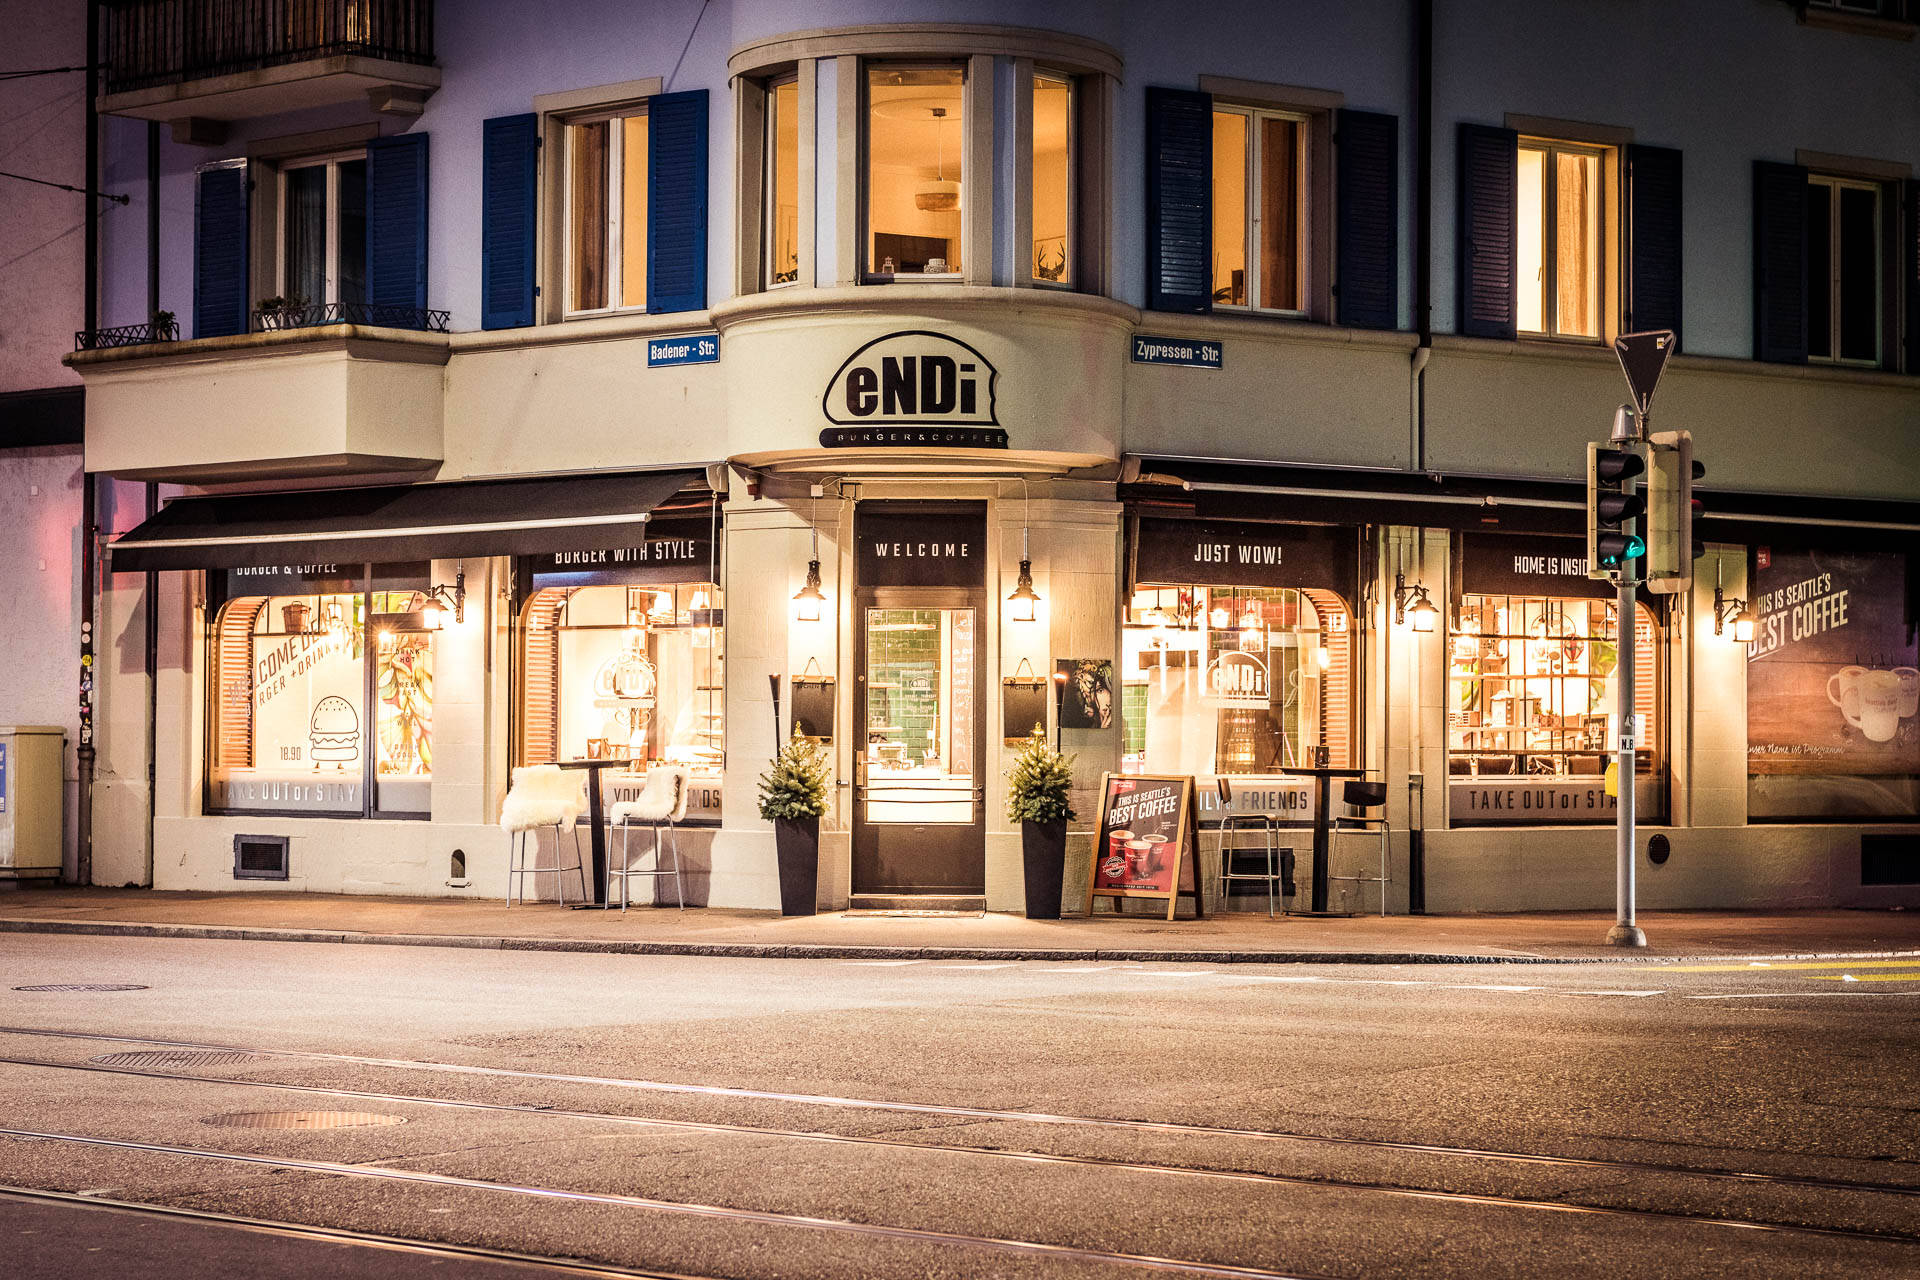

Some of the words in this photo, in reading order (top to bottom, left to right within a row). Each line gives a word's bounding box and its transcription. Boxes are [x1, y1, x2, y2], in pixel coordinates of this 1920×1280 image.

[651, 344, 689, 360] Badener
[698, 340, 715, 356] Str.
[1137, 341, 1192, 360] Zypressen
[1202, 345, 1219, 362] Str.
[846, 355, 976, 417] eNDi
[655, 540, 695, 560] STYLE
[875, 543, 968, 557] WELCOME
[1194, 543, 1230, 563] JUST
[1238, 545, 1282, 565] WOW!
[1514, 555, 1545, 574] HOME
[1547, 557, 1558, 575] IS
[1560, 558, 1588, 576] INSID
[1757, 593, 1772, 616] HIS
[1775, 589, 1784, 610] IS
[1786, 573, 1831, 606] SEATTLE'S
[1792, 589, 1848, 642] COFFEE
[281, 746, 301, 760] 18.90
[219, 781, 255, 799] TAKE
[317, 784, 355, 801] STAY
[1118, 796, 1132, 808] THIS
[1132, 793, 1140, 804] IS
[1140, 786, 1171, 802] SEATTLE'S
[1242, 791, 1307, 809] FRIENDS
[1470, 790, 1514, 809] TAKE
[1108, 804, 1138, 826] BEST
[1138, 795, 1178, 820] COFFEE
